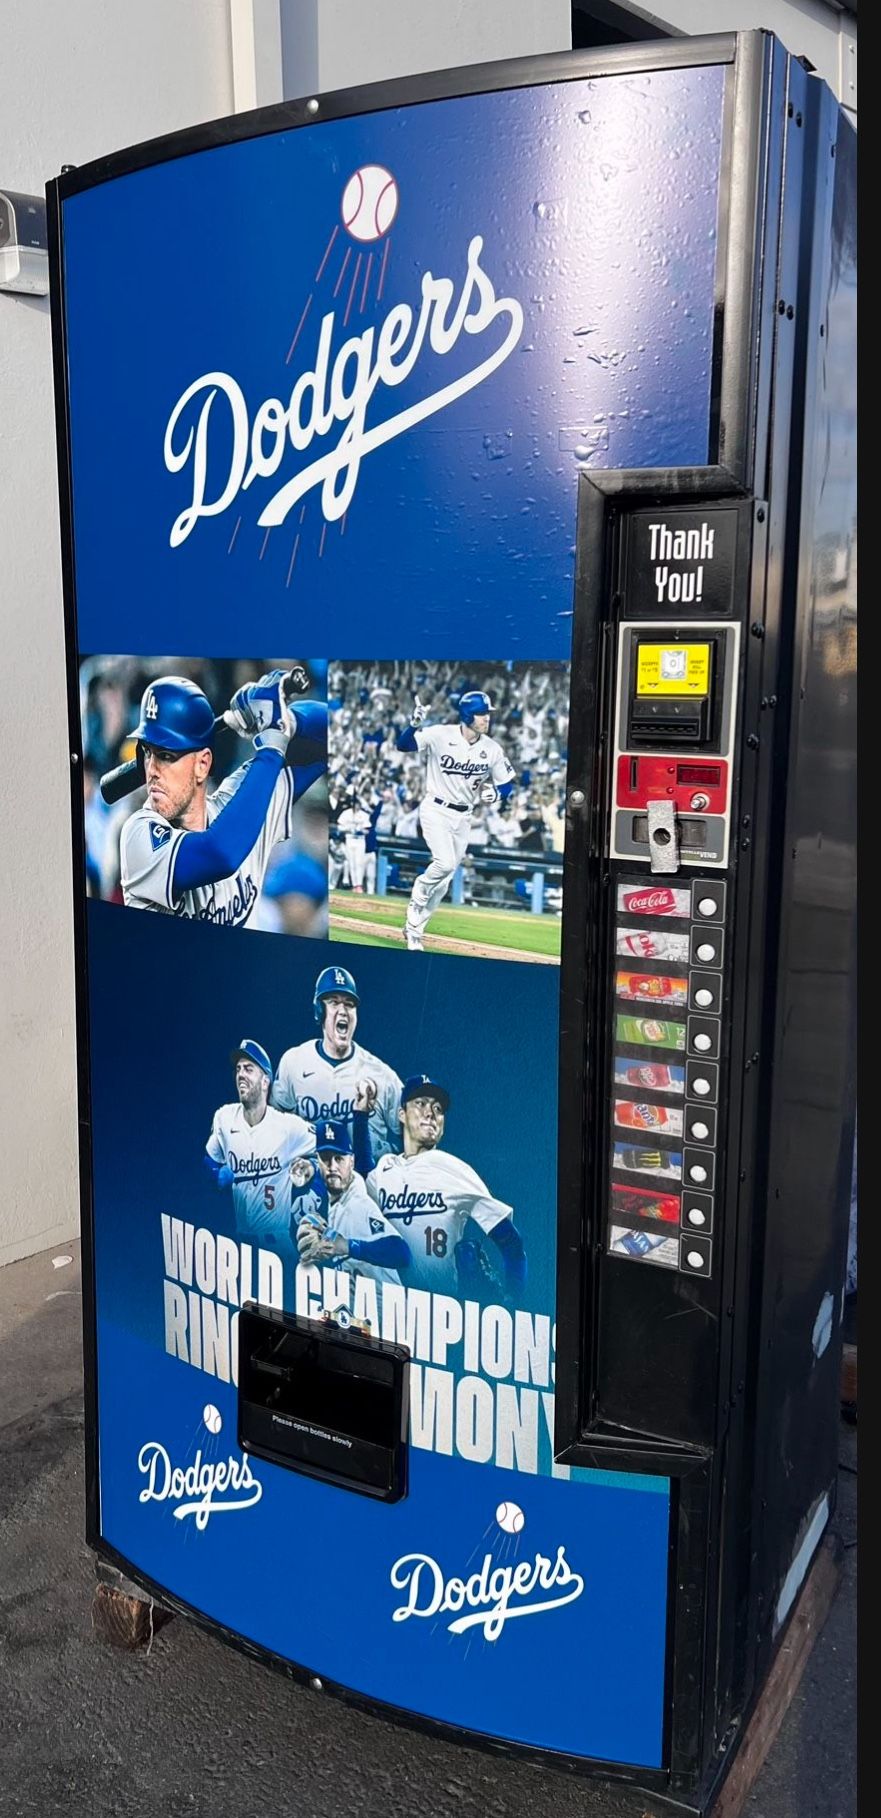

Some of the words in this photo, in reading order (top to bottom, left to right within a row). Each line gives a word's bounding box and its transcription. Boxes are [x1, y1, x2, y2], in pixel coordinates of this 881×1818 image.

[164, 235, 524, 549] Dodgers
[648, 523, 716, 561] Thank
[655, 566, 703, 602] You!
[440, 754, 489, 779] Dodgers
[472, 779, 482, 791] 5
[334, 969, 346, 985] LA
[325, 1124, 336, 1140] LA
[227, 1150, 283, 1187] Dodgers
[263, 1185, 275, 1211] 5
[424, 1226, 448, 1258] 18
[161, 1213, 283, 1312] WORLD
[295, 1263, 556, 1388] CHAMPION
[163, 1279, 240, 1388] RIN
[272, 1414, 293, 1427] Please
[293, 1422, 309, 1432] open
[310, 1427, 331, 1440] bottles
[332, 1436, 353, 1448] slowly
[138, 1441, 263, 1530] Dodgers
[389, 1546, 584, 1642] Dodgers
